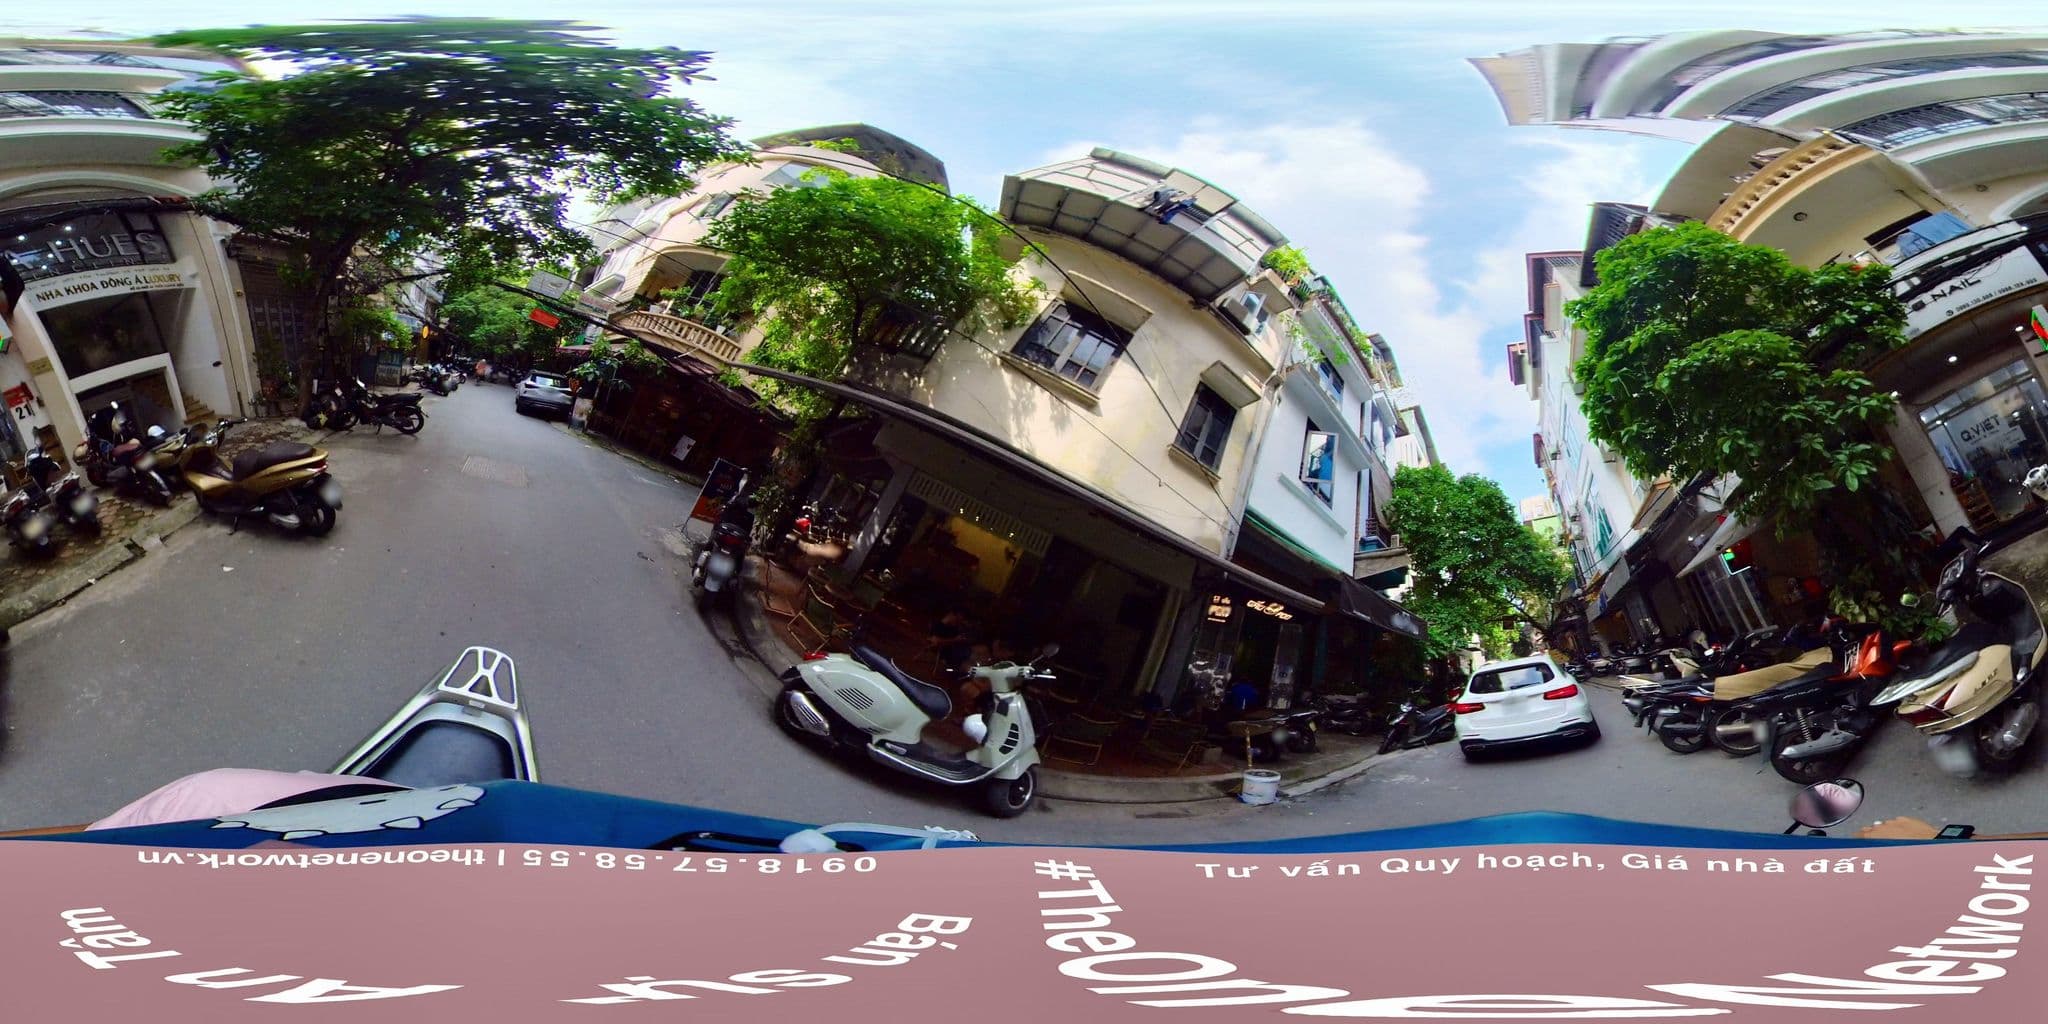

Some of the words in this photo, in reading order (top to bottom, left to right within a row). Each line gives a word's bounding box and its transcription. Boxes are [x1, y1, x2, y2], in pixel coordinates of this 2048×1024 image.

[36, 290, 65, 303] NHA
[65, 280, 99, 296] KHOA
[144, 273, 182, 286] LUXURY
[1930, 278, 1981, 303] NAIL
